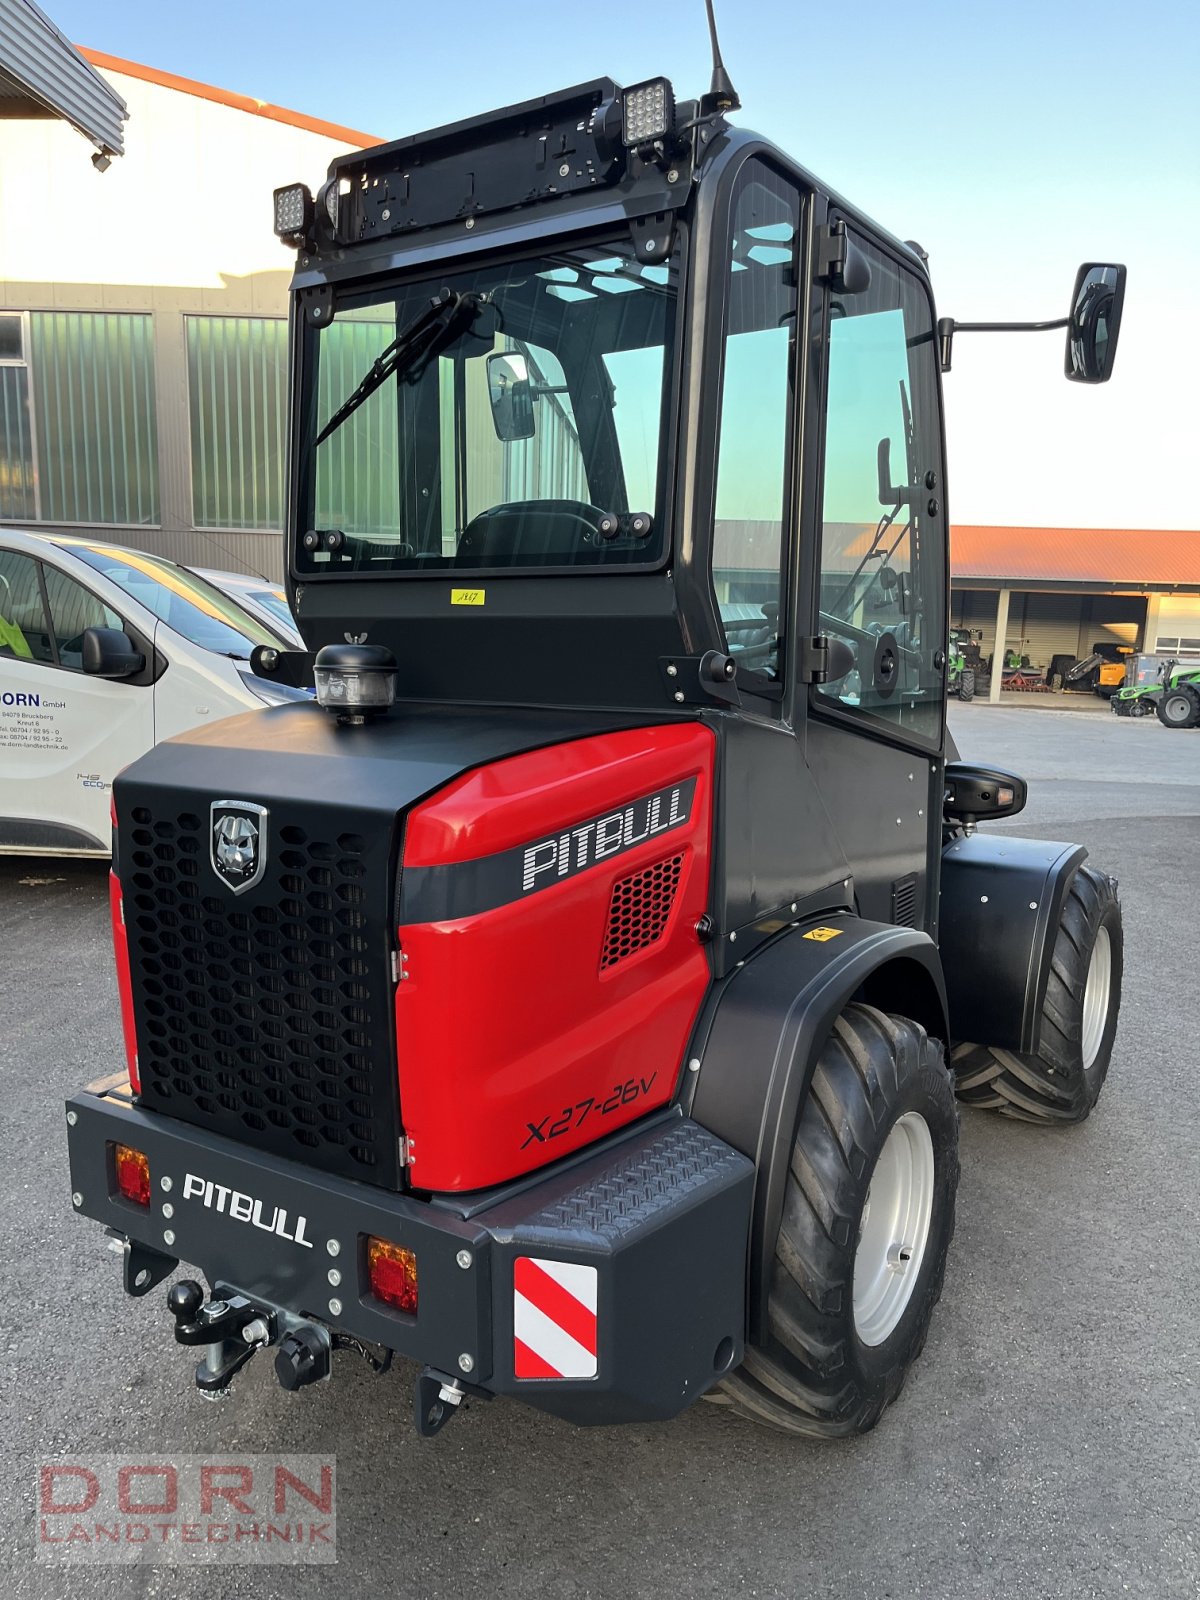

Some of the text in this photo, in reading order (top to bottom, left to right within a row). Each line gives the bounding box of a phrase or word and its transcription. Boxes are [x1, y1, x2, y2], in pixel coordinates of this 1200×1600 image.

[0, 692, 66, 709] ORN GmbH
[21, 712, 54, 721] Bruckberg
[522, 788, 686, 891] PITBULL
[520, 1072, 657, 1150] X27-26V
[182, 1173, 314, 1249] PITBULL
